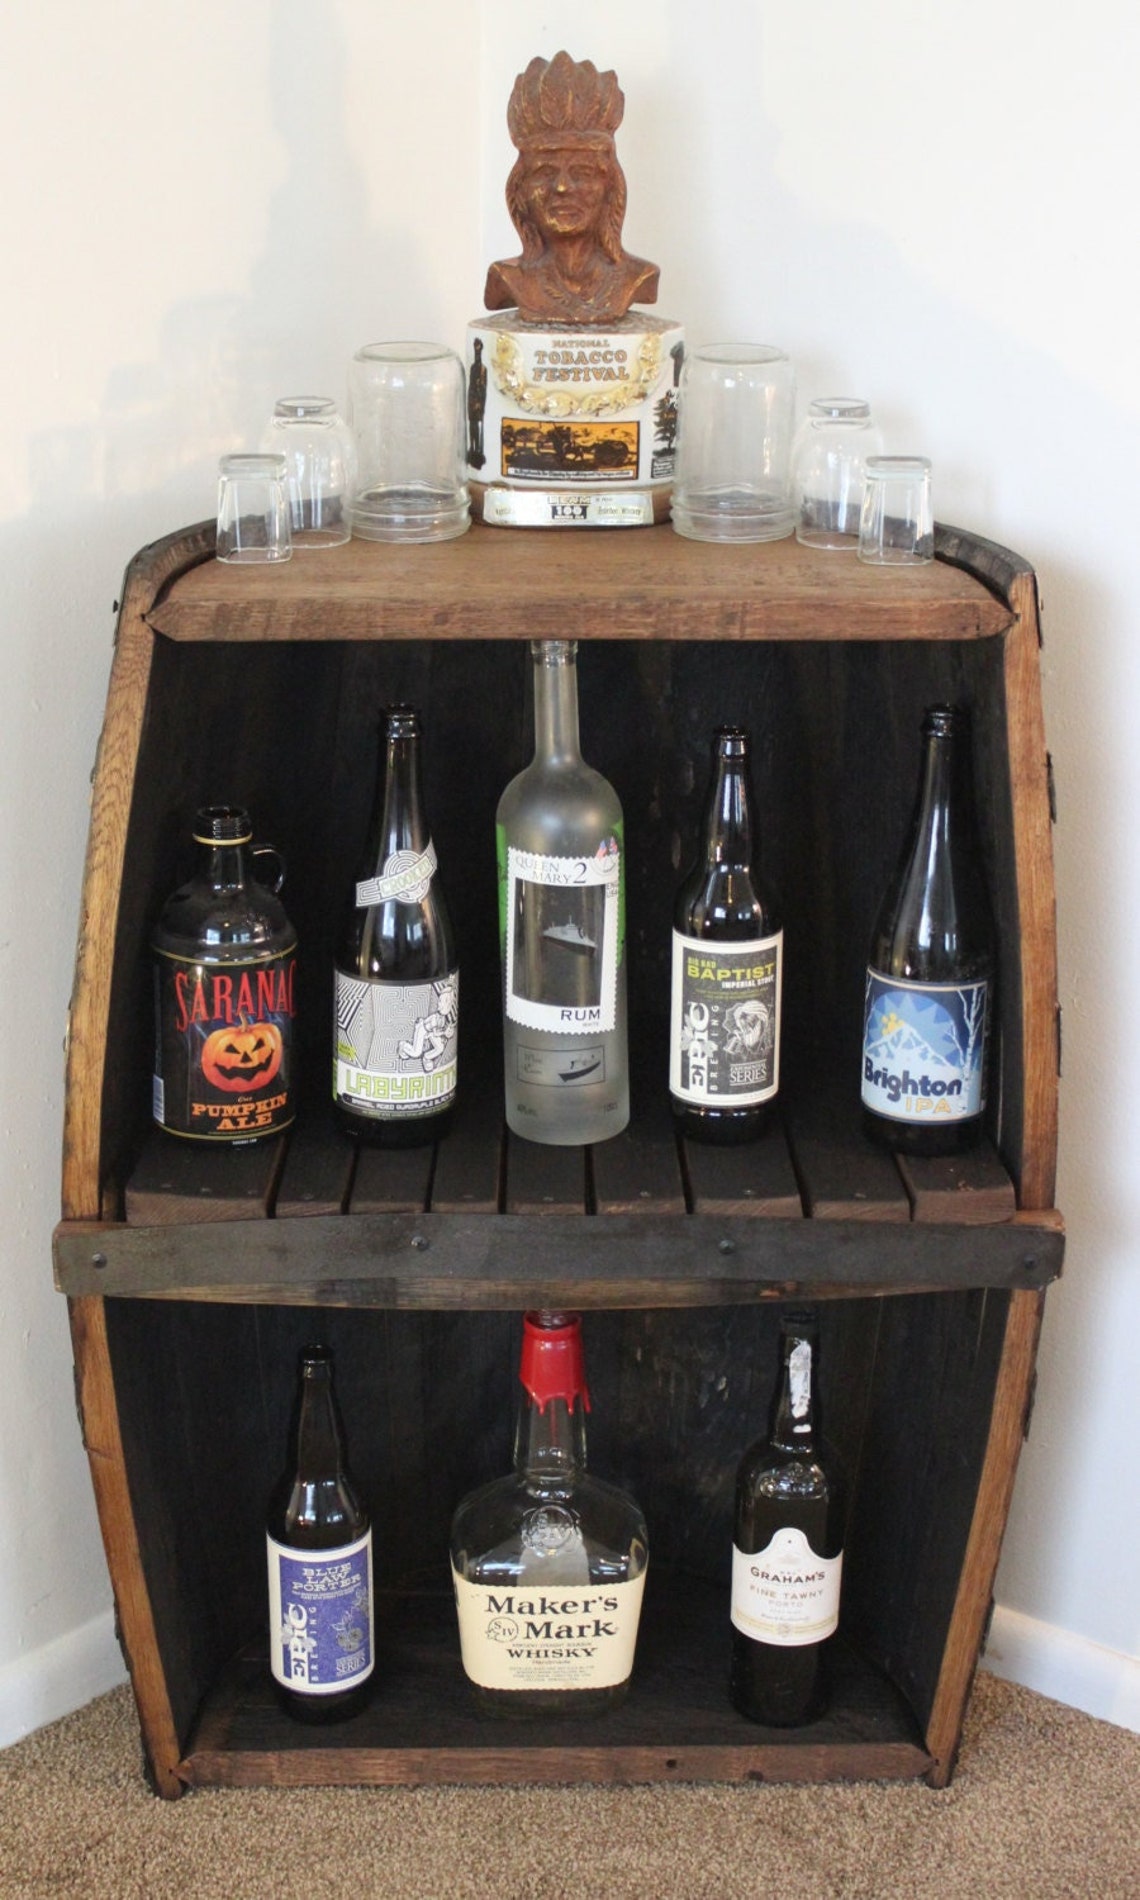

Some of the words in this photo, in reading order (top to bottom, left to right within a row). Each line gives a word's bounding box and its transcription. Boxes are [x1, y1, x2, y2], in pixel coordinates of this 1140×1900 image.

[552, 339, 610, 348] NATIONAL
[534, 350, 628, 366] TOBACCO
[533, 366, 630, 382] FESTIVAL
[516, 855, 560, 873] QUEEN
[533, 871, 569, 884] MARY
[573, 862, 587, 884] 2
[687, 962, 775, 981] BAPTIST
[560, 1008, 601, 1021] RUM
[730, 1068, 768, 1083] SERIES
[864, 1057, 962, 1103] Brighton
[192, 1092, 288, 1118] PUMPKIN
[905, 1097, 952, 1114] IPA
[216, 1112, 273, 1131] ALE
[302, 1562, 351, 1577] BLUE
[306, 1571, 349, 1584] LAW
[750, 1566, 825, 1584] GRAHAM'S
[292, 1573, 361, 1591] PORTER
[750, 1584, 776, 1598] FINE
[784, 1589, 823, 1600] TAWNY
[485, 1594, 619, 1616] Maker's
[524, 1619, 617, 1640] Mark
[506, 1647, 598, 1659] WHISKY
